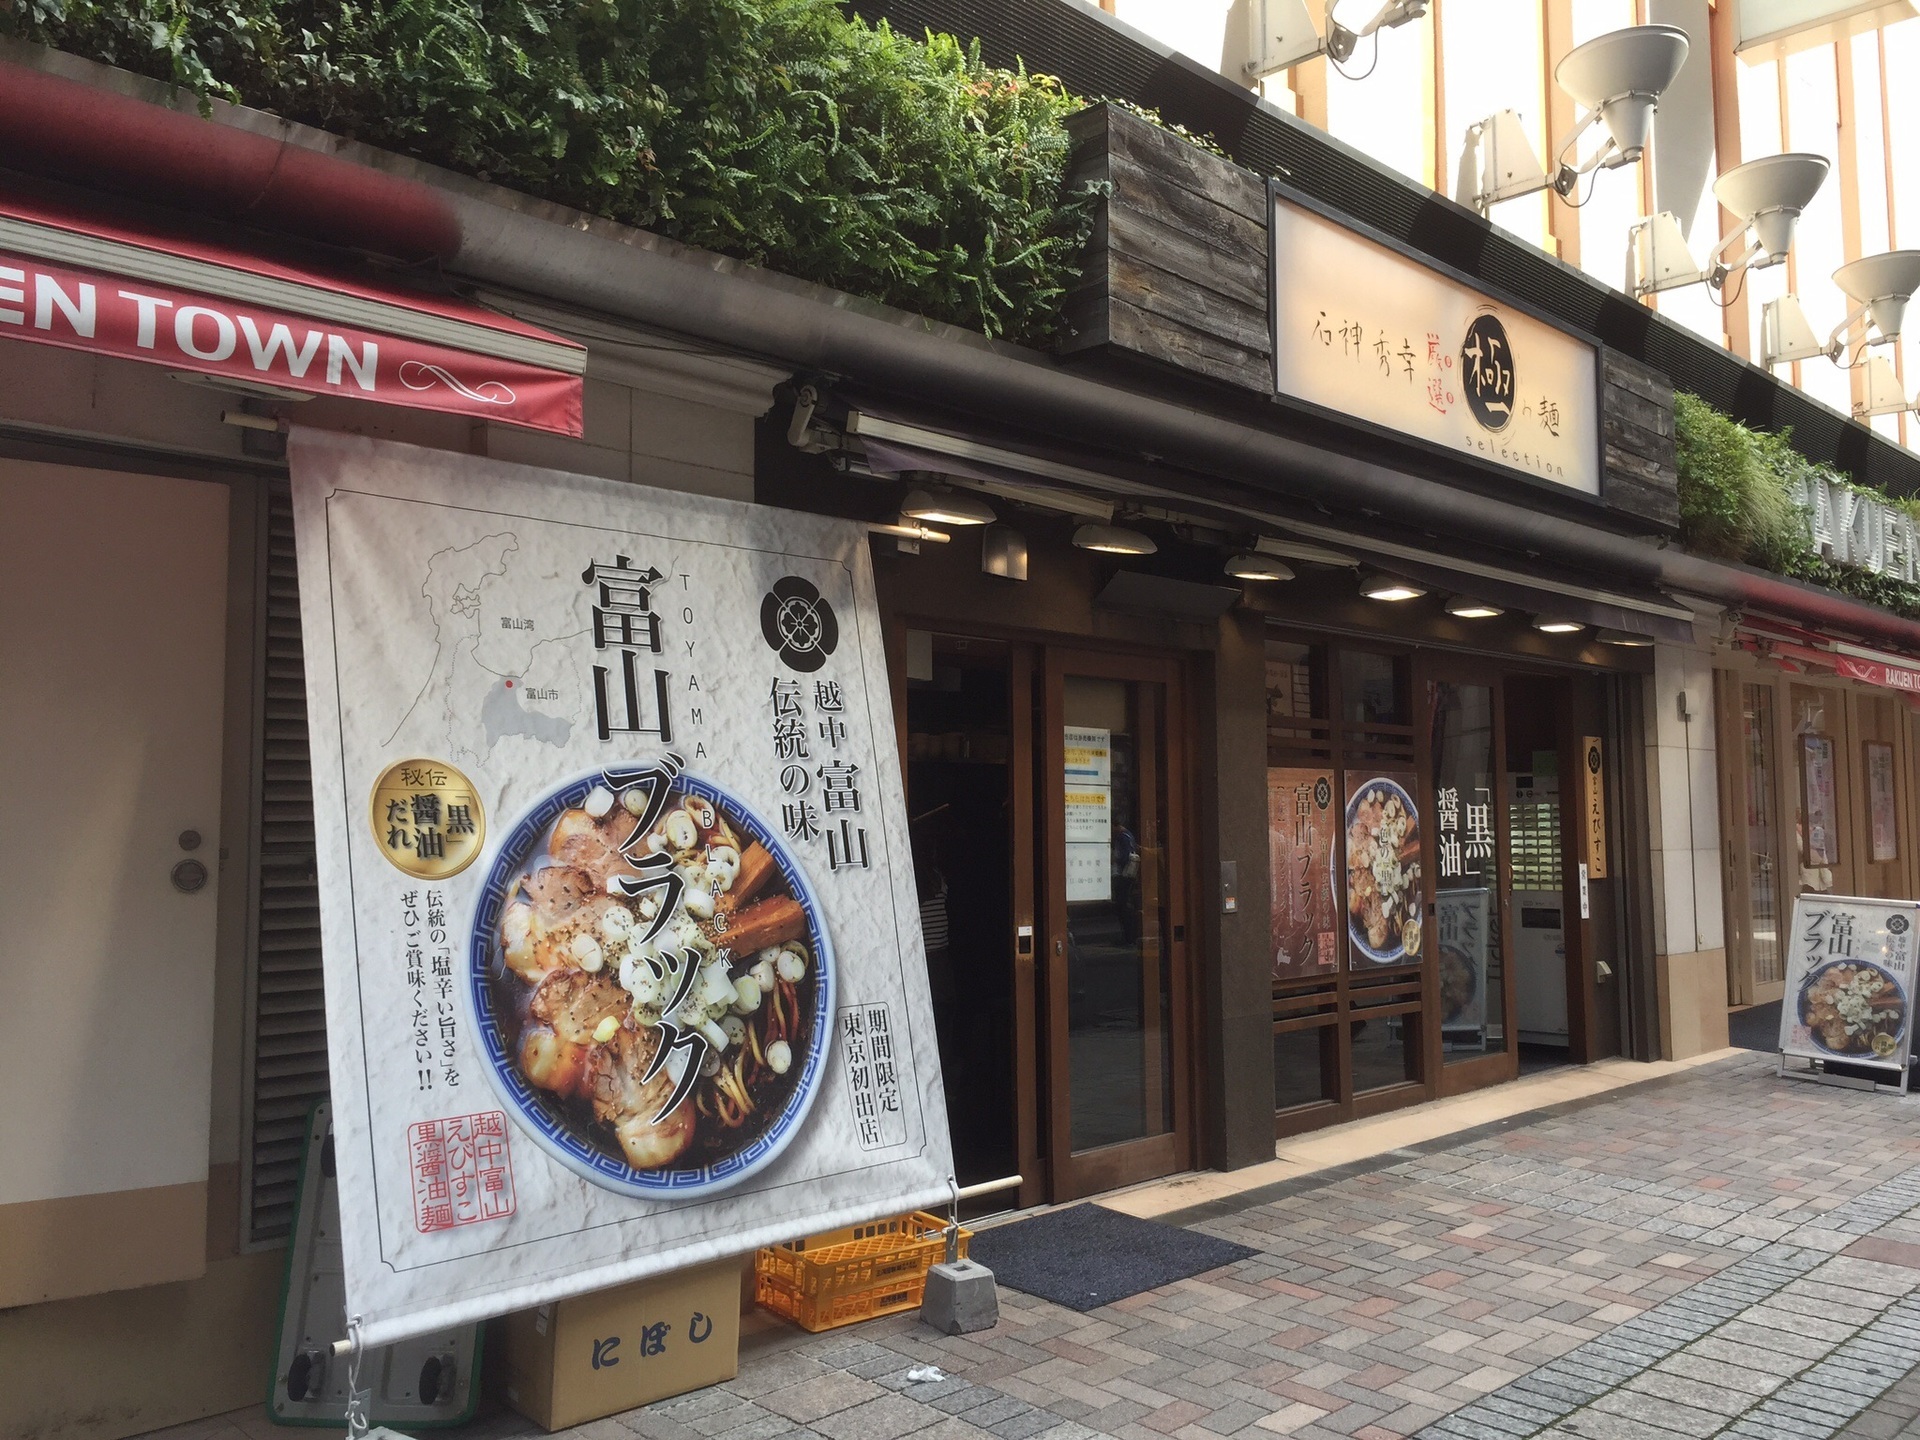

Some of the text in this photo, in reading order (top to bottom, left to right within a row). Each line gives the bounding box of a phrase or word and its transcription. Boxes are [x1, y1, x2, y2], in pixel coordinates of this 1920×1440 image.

[118, 289, 379, 392] TOWN
[1465, 433, 1565, 478] selection
[500, 616, 535, 631] 富山湾
[679, 573, 708, 760] TOYAMA
[525, 687, 559, 701] 富山市
[1885, 667, 1914, 688] RAKUEN
[401, 768, 447, 787] 秘伝
[770, 677, 820, 842] 伝統の味
[813, 680, 869, 871] 越中富山
[385, 798, 412, 849] だれ
[410, 793, 444, 858] 醤油
[445, 796, 475, 843] 「黒」
[581, 554, 708, 1127] 富山ブラック
[1437, 787, 1461, 877] 醤油
[1464, 787, 1492, 875] 「黒」
[702, 809, 732, 970] BLACK
[1293, 782, 1315, 967] 富山ブラック
[1798, 909, 1831, 993] ブラック
[1829, 912, 1857, 957] 富山
[426, 890, 460, 1087] 伝統の「塩辛い旨さ」を
[843, 1015, 879, 1145] 東京初出店
[868, 1008, 900, 1114] 期間限定
[447, 1120, 477, 1221] えびすこ
[473, 1114, 510, 1217] 越中富山
[591, 1311, 713, 1371] にぼし
